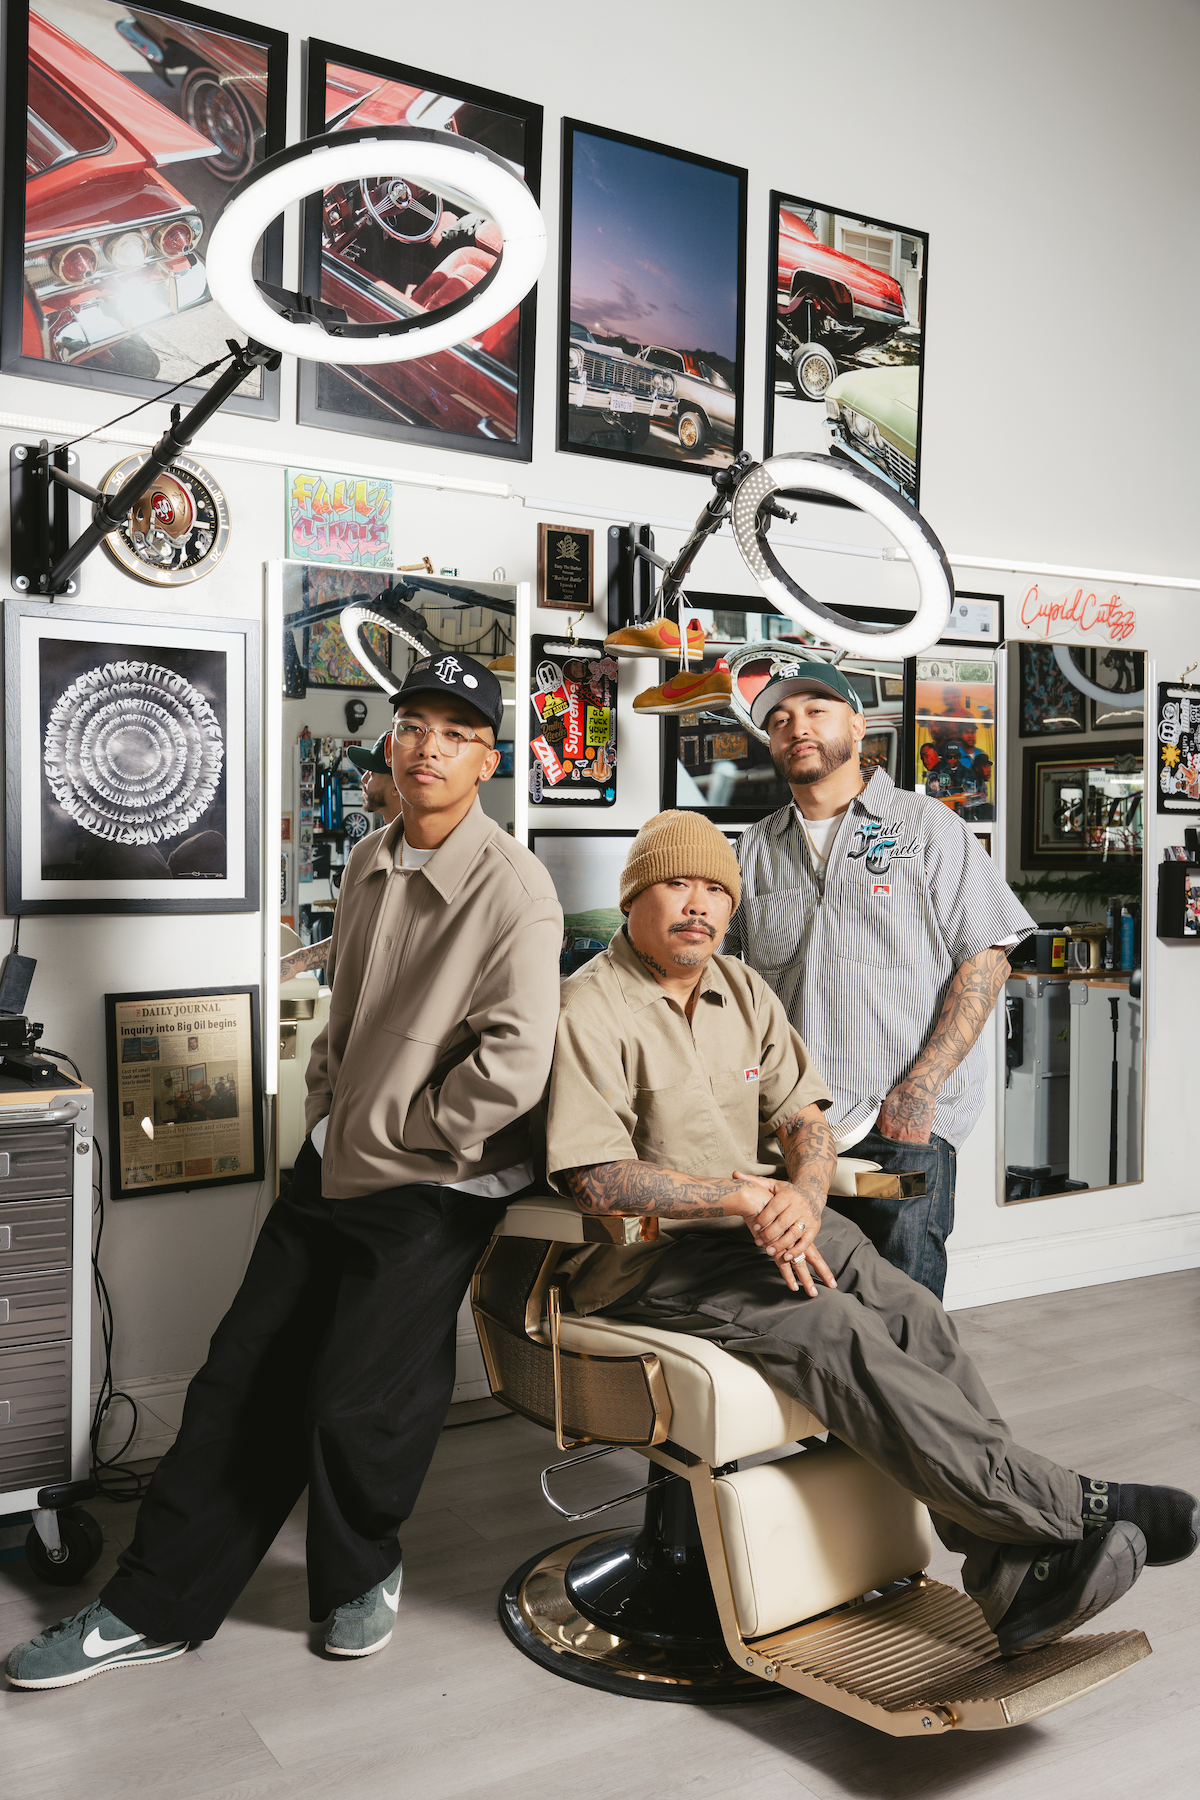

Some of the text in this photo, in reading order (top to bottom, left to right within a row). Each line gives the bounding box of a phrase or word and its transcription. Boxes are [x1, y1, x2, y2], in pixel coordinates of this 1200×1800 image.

[111, 471, 125, 486] 50
[213, 489, 224, 504] 10
[210, 550, 222, 562] 20
[1021, 587, 1082, 636] Cupid
[847, 821, 904, 860] Full
[142, 1006, 173, 1017] DAILY
[174, 1003, 221, 1018] JOURNAL
[121, 1018, 237, 1036] Inquiry into Big Oil begins
[154, 1127, 177, 1135] Bonded
[216, 1121, 240, 1129] clippers
